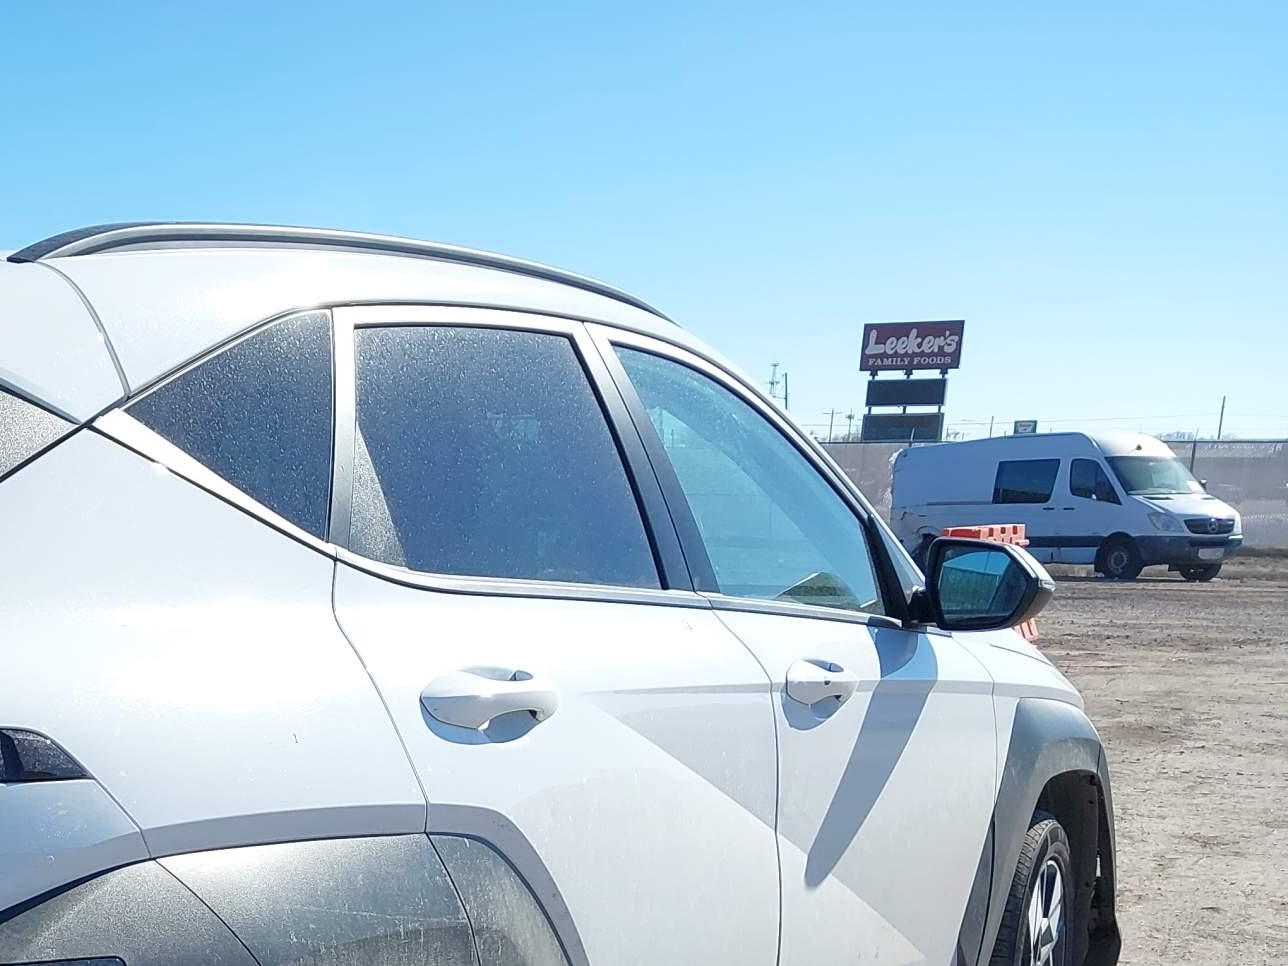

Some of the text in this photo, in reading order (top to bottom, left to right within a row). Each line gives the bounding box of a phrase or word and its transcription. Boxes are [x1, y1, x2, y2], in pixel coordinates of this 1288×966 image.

[865, 328, 960, 355] Leeker's
[868, 356, 952, 366] FAMILY FOODS
